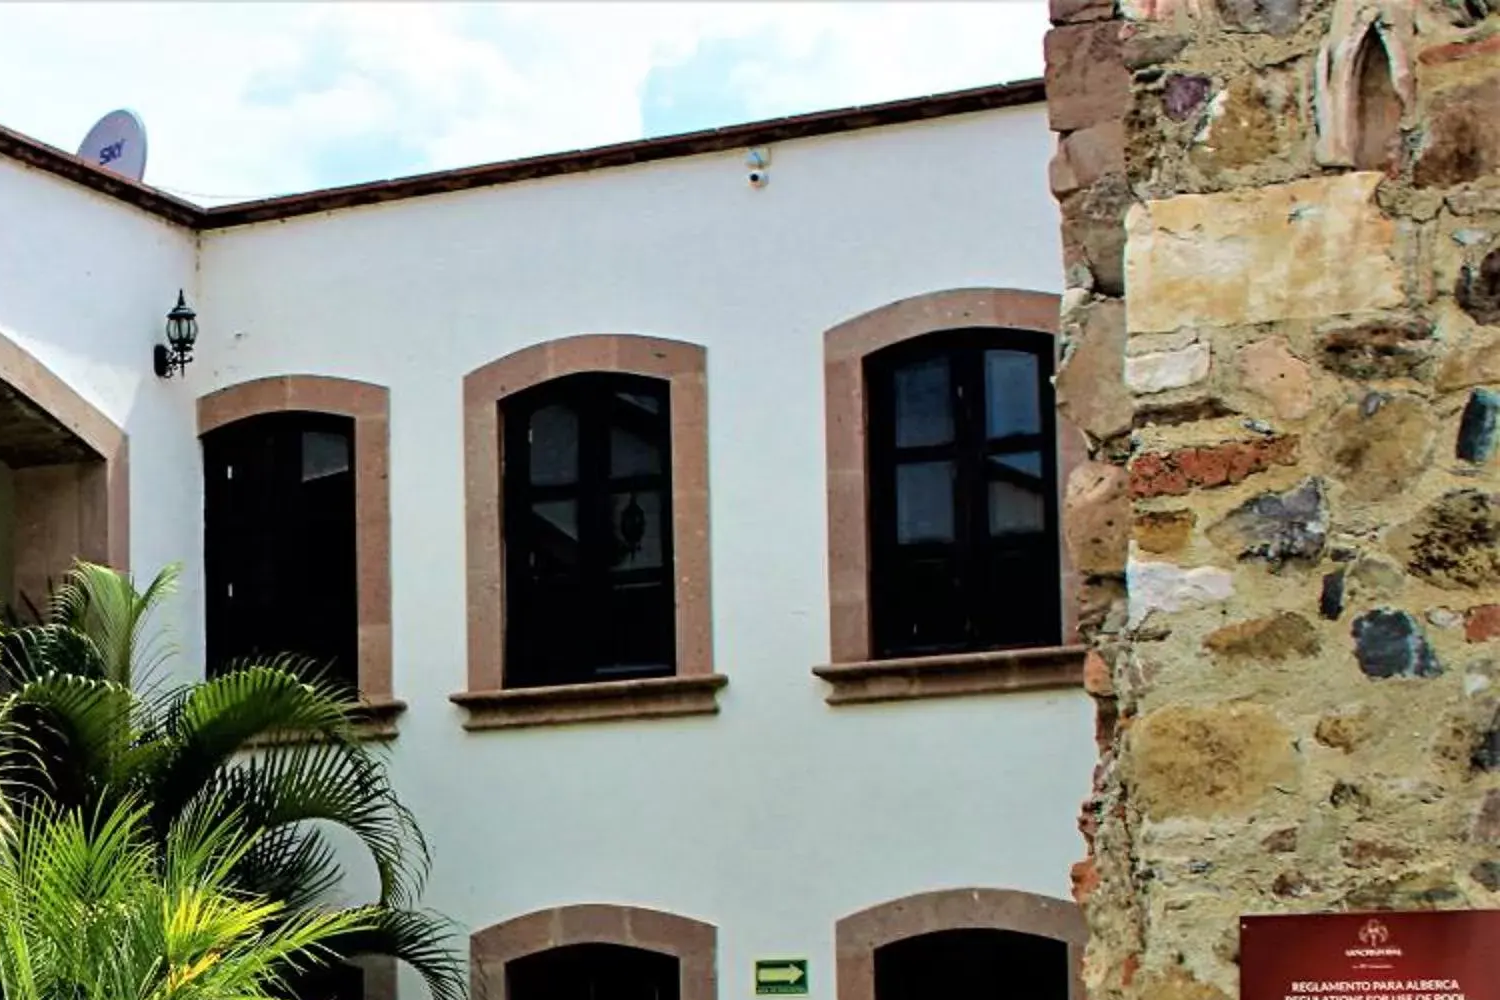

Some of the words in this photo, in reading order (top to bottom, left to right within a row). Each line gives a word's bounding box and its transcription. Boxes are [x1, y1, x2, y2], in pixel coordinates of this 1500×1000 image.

[99, 138, 126, 165] SKY
[1291, 981, 1371, 992] REGLAMENTO
[1372, 981, 1404, 991] PARA
[1405, 979, 1460, 991] ALBERCA
